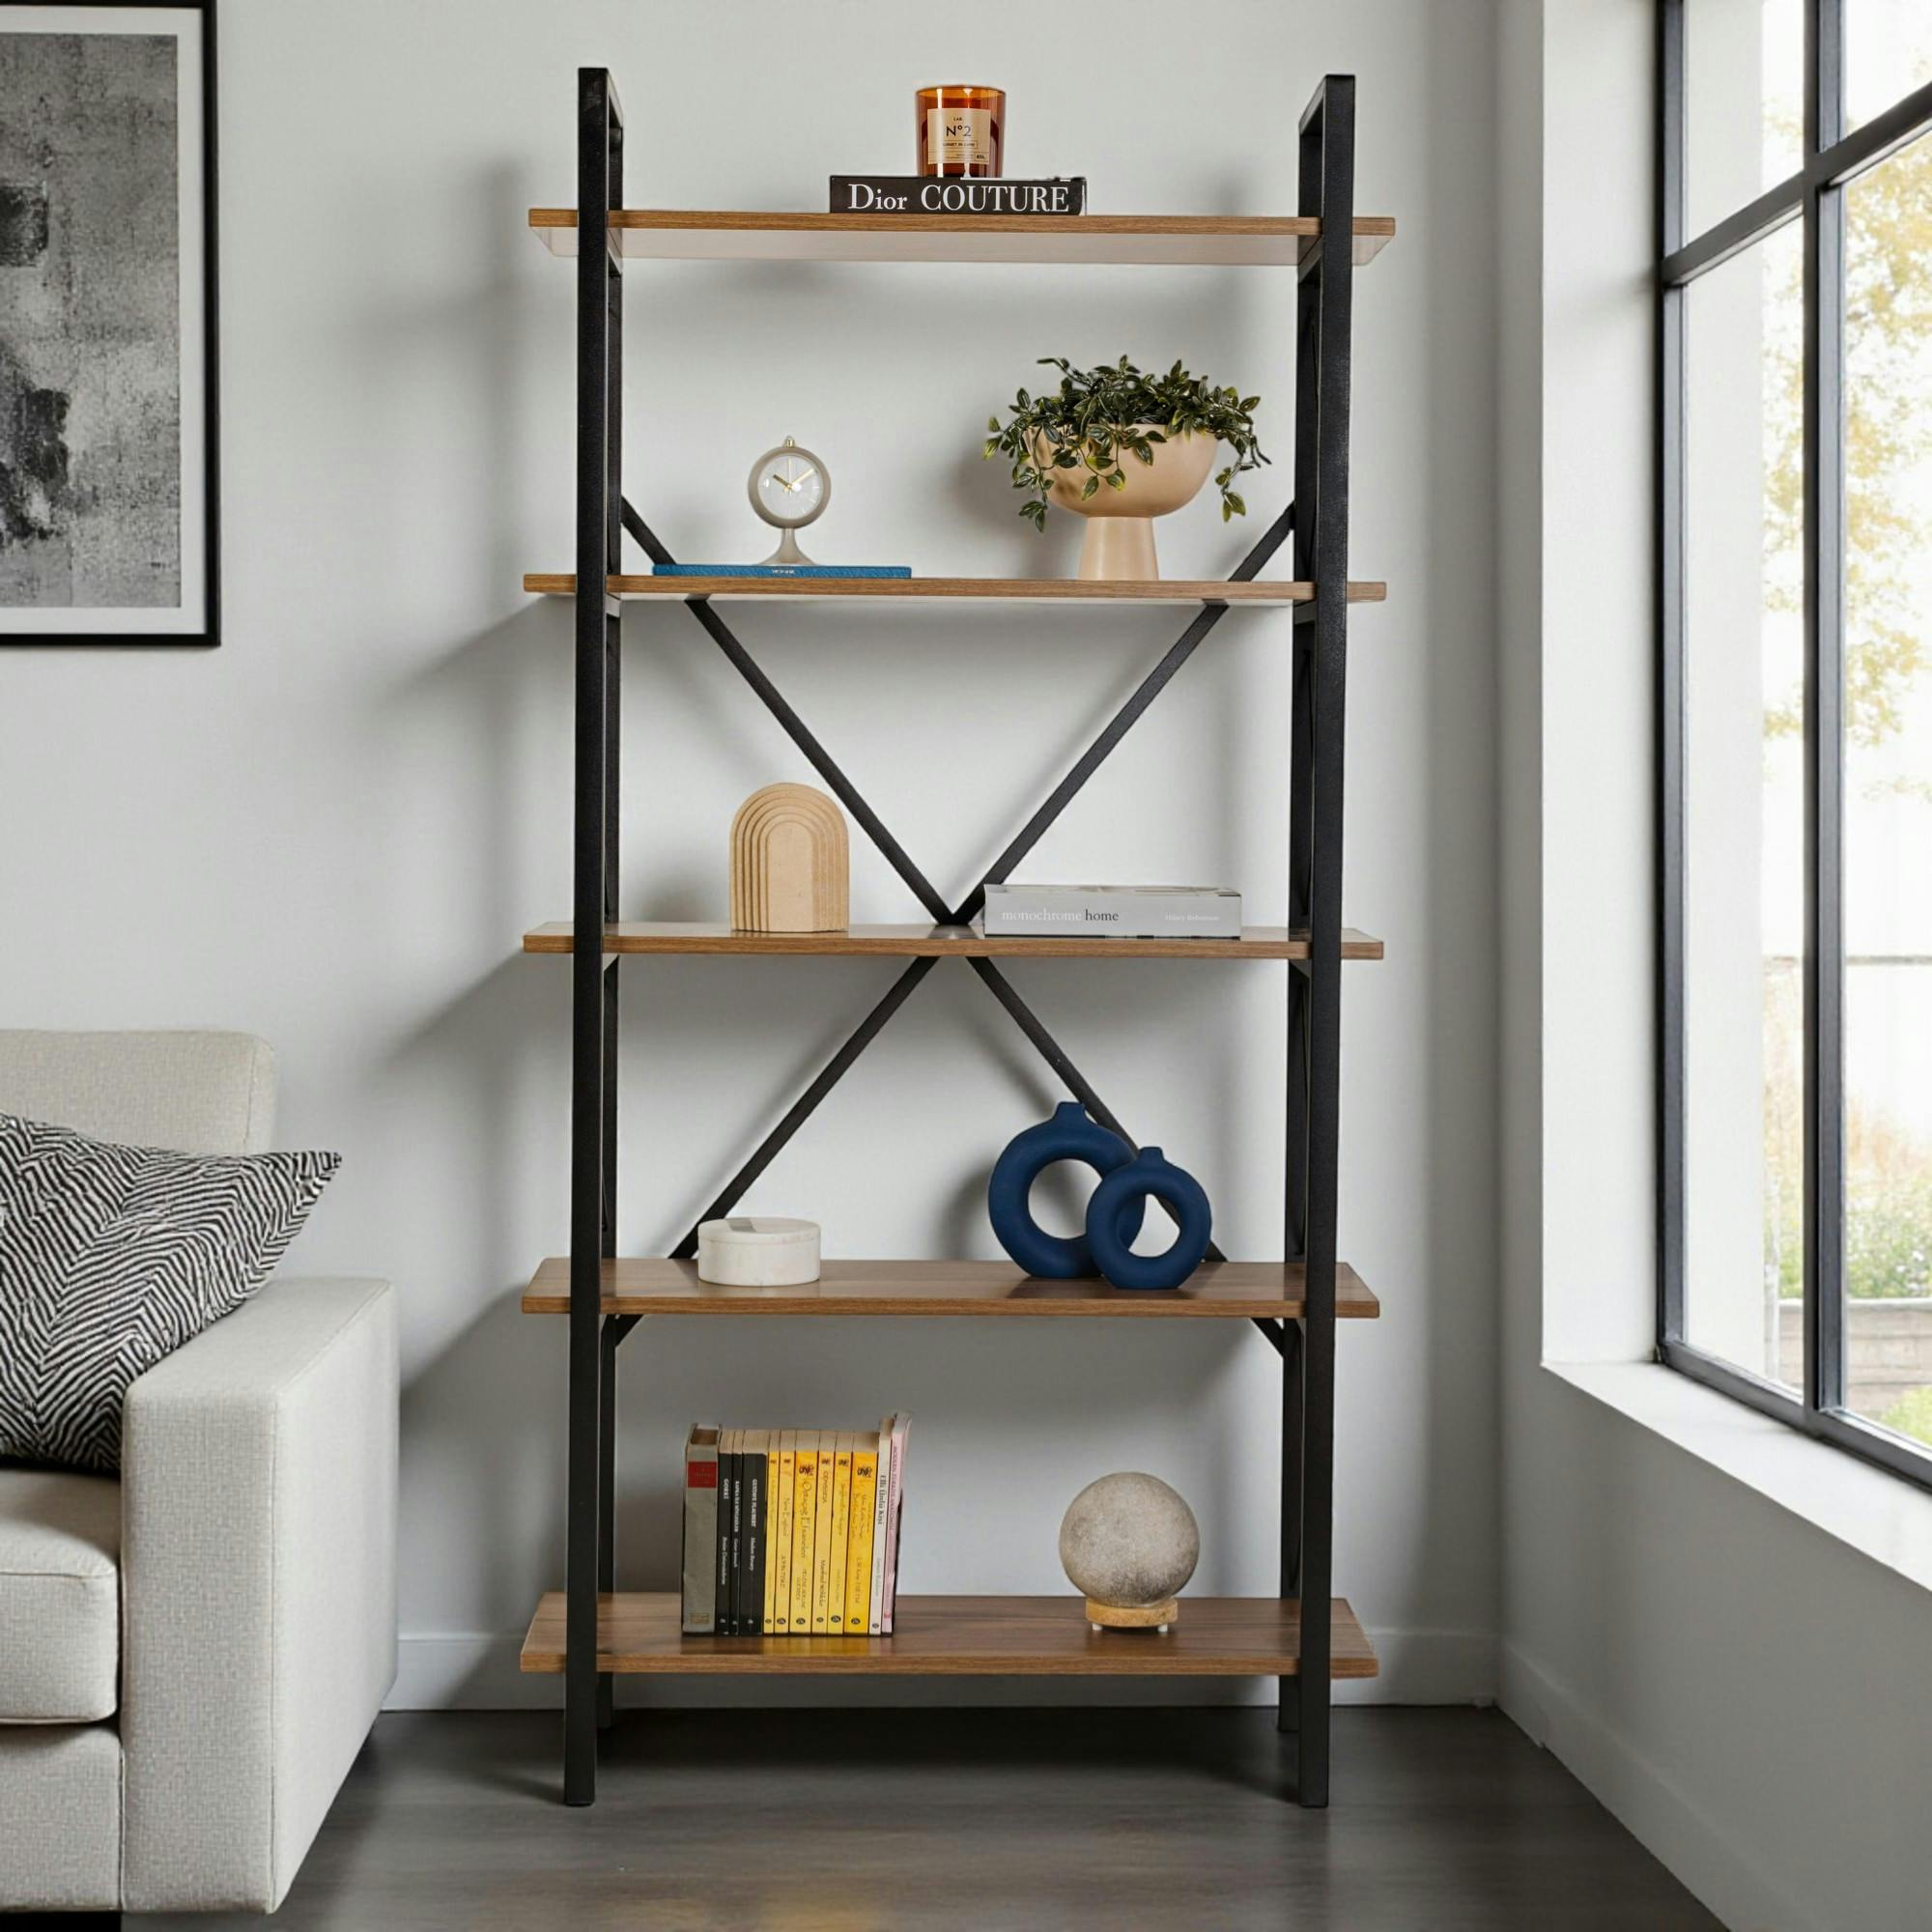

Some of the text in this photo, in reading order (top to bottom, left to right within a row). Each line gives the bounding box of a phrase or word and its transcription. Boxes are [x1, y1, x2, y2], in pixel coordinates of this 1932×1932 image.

[847, 183, 1069, 213] Dior COUTURE
[1002, 908, 1120, 922] monochrome home
